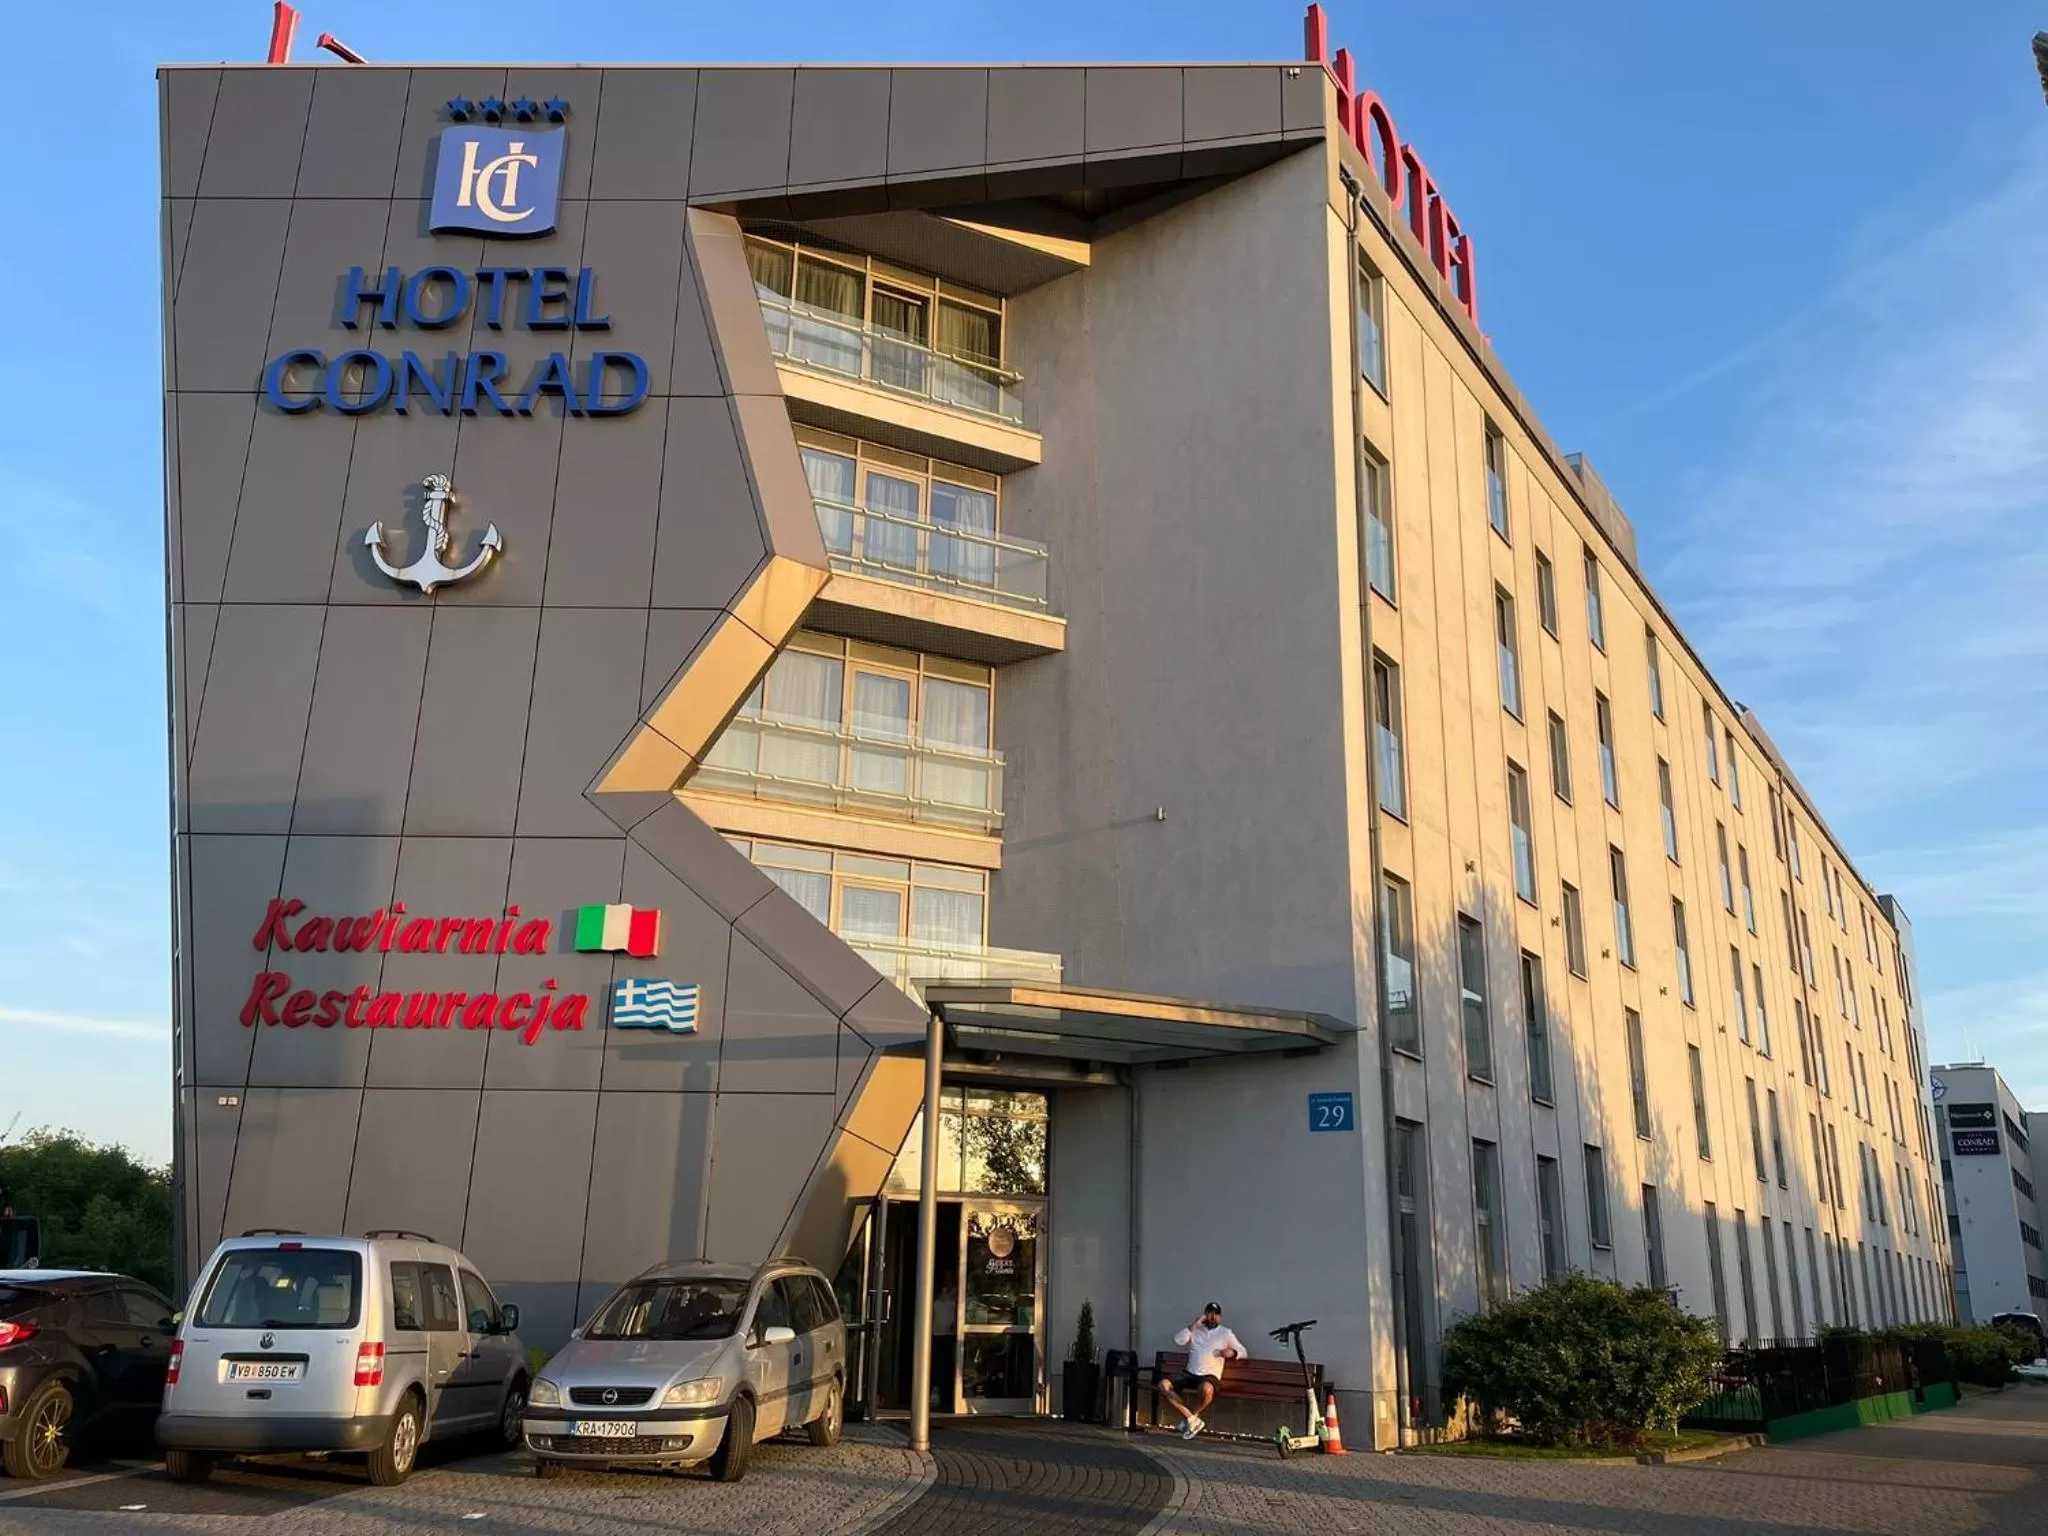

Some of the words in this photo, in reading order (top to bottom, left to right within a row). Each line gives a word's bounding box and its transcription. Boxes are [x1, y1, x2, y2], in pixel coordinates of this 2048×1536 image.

[341, 265, 614, 330] HOTEL
[265, 348, 651, 418] CONRAD
[252, 897, 553, 955] Kawiarnia
[239, 971, 589, 1045] Restauracja
[1318, 1105, 1344, 1127] 29
[238, 1365, 251, 1377] VB
[281, 1366, 297, 1378] EW
[577, 1422, 597, 1435] KRA
[602, 1423, 634, 1435] 17906
